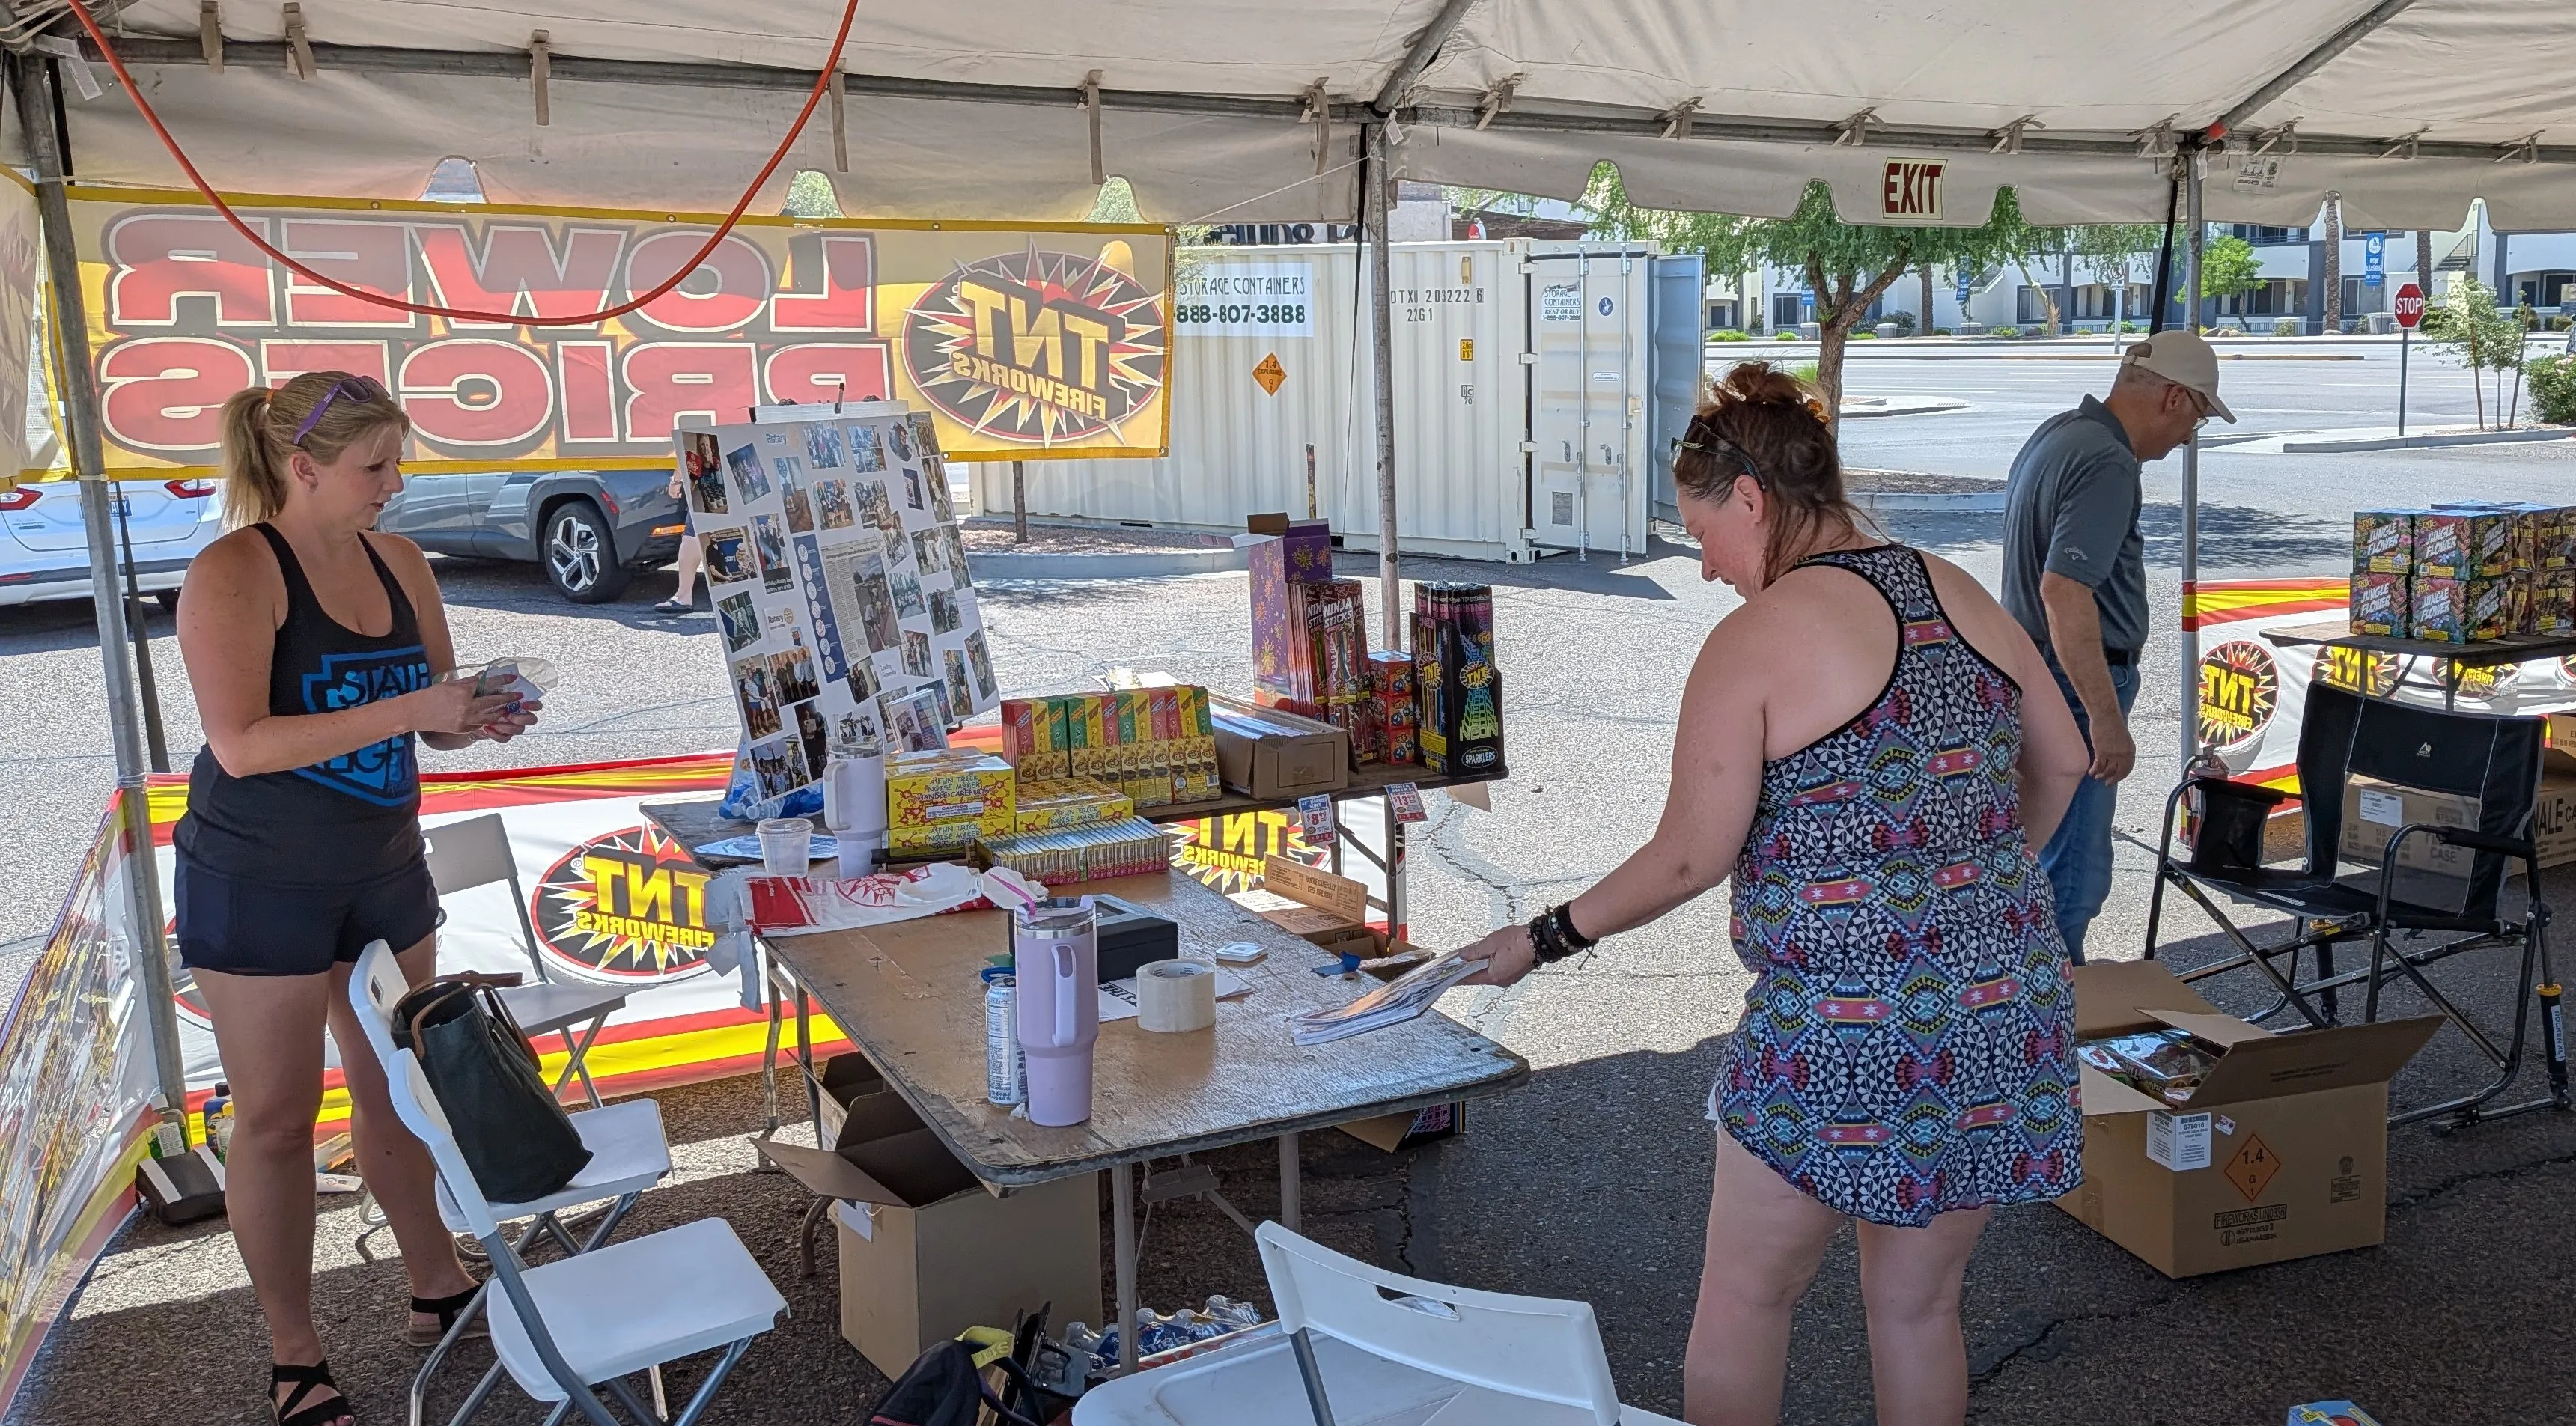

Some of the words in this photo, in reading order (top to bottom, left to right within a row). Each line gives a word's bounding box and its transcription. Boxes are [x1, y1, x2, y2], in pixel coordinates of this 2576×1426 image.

[1884, 162, 1942, 214] EXIT
[1180, 277, 1230, 296] STORAGE
[1233, 277, 1306, 295] CONTAINERS
[1425, 289, 1470, 303] 203222
[1476, 288, 1483, 302] 6
[1544, 298, 1580, 306] CONTAINERS
[2396, 297, 2423, 314] STOP
[1407, 308, 1434, 322] 22G1
[1264, 359, 1277, 369] 1.4
[2368, 522, 2398, 544] JUNGLE
[2427, 523, 2455, 545] JUNGLE
[2366, 534, 2399, 556] FLOWER
[2426, 535, 2458, 559] FLOWER
[2482, 533, 2506, 559] FLOWER
[2360, 582, 2390, 603] JUNGLE
[2422, 588, 2449, 608] JUNGLE
[1307, 602, 1324, 618] NIN
[1324, 597, 1353, 617] NINJA
[2360, 594, 2392, 617] FLOWER
[2420, 600, 2451, 623] FLOWER
[1308, 614, 1324, 629] STIC
[1324, 609, 1353, 628] STICKS
[1423, 662, 1438, 681] TNT
[1467, 667, 1486, 684] TNT
[1459, 722, 1499, 742] NEON
[1465, 751, 1496, 764] SPARKLERS
[928, 784, 952, 792] NOISE
[955, 781, 981, 790] MAKER
[957, 774, 978, 782] TRICK
[928, 833, 953, 842] NOISE
[956, 830, 981, 838] MAKER
[957, 823, 978, 832] TRICK
[951, 838, 973, 847] CAREF
[2242, 1148, 2265, 1166] 1.4
[2248, 1174, 2256, 1184] G
[2250, 1188, 2255, 1197] 1
[2217, 1210, 2259, 1227] FIREWORKS
